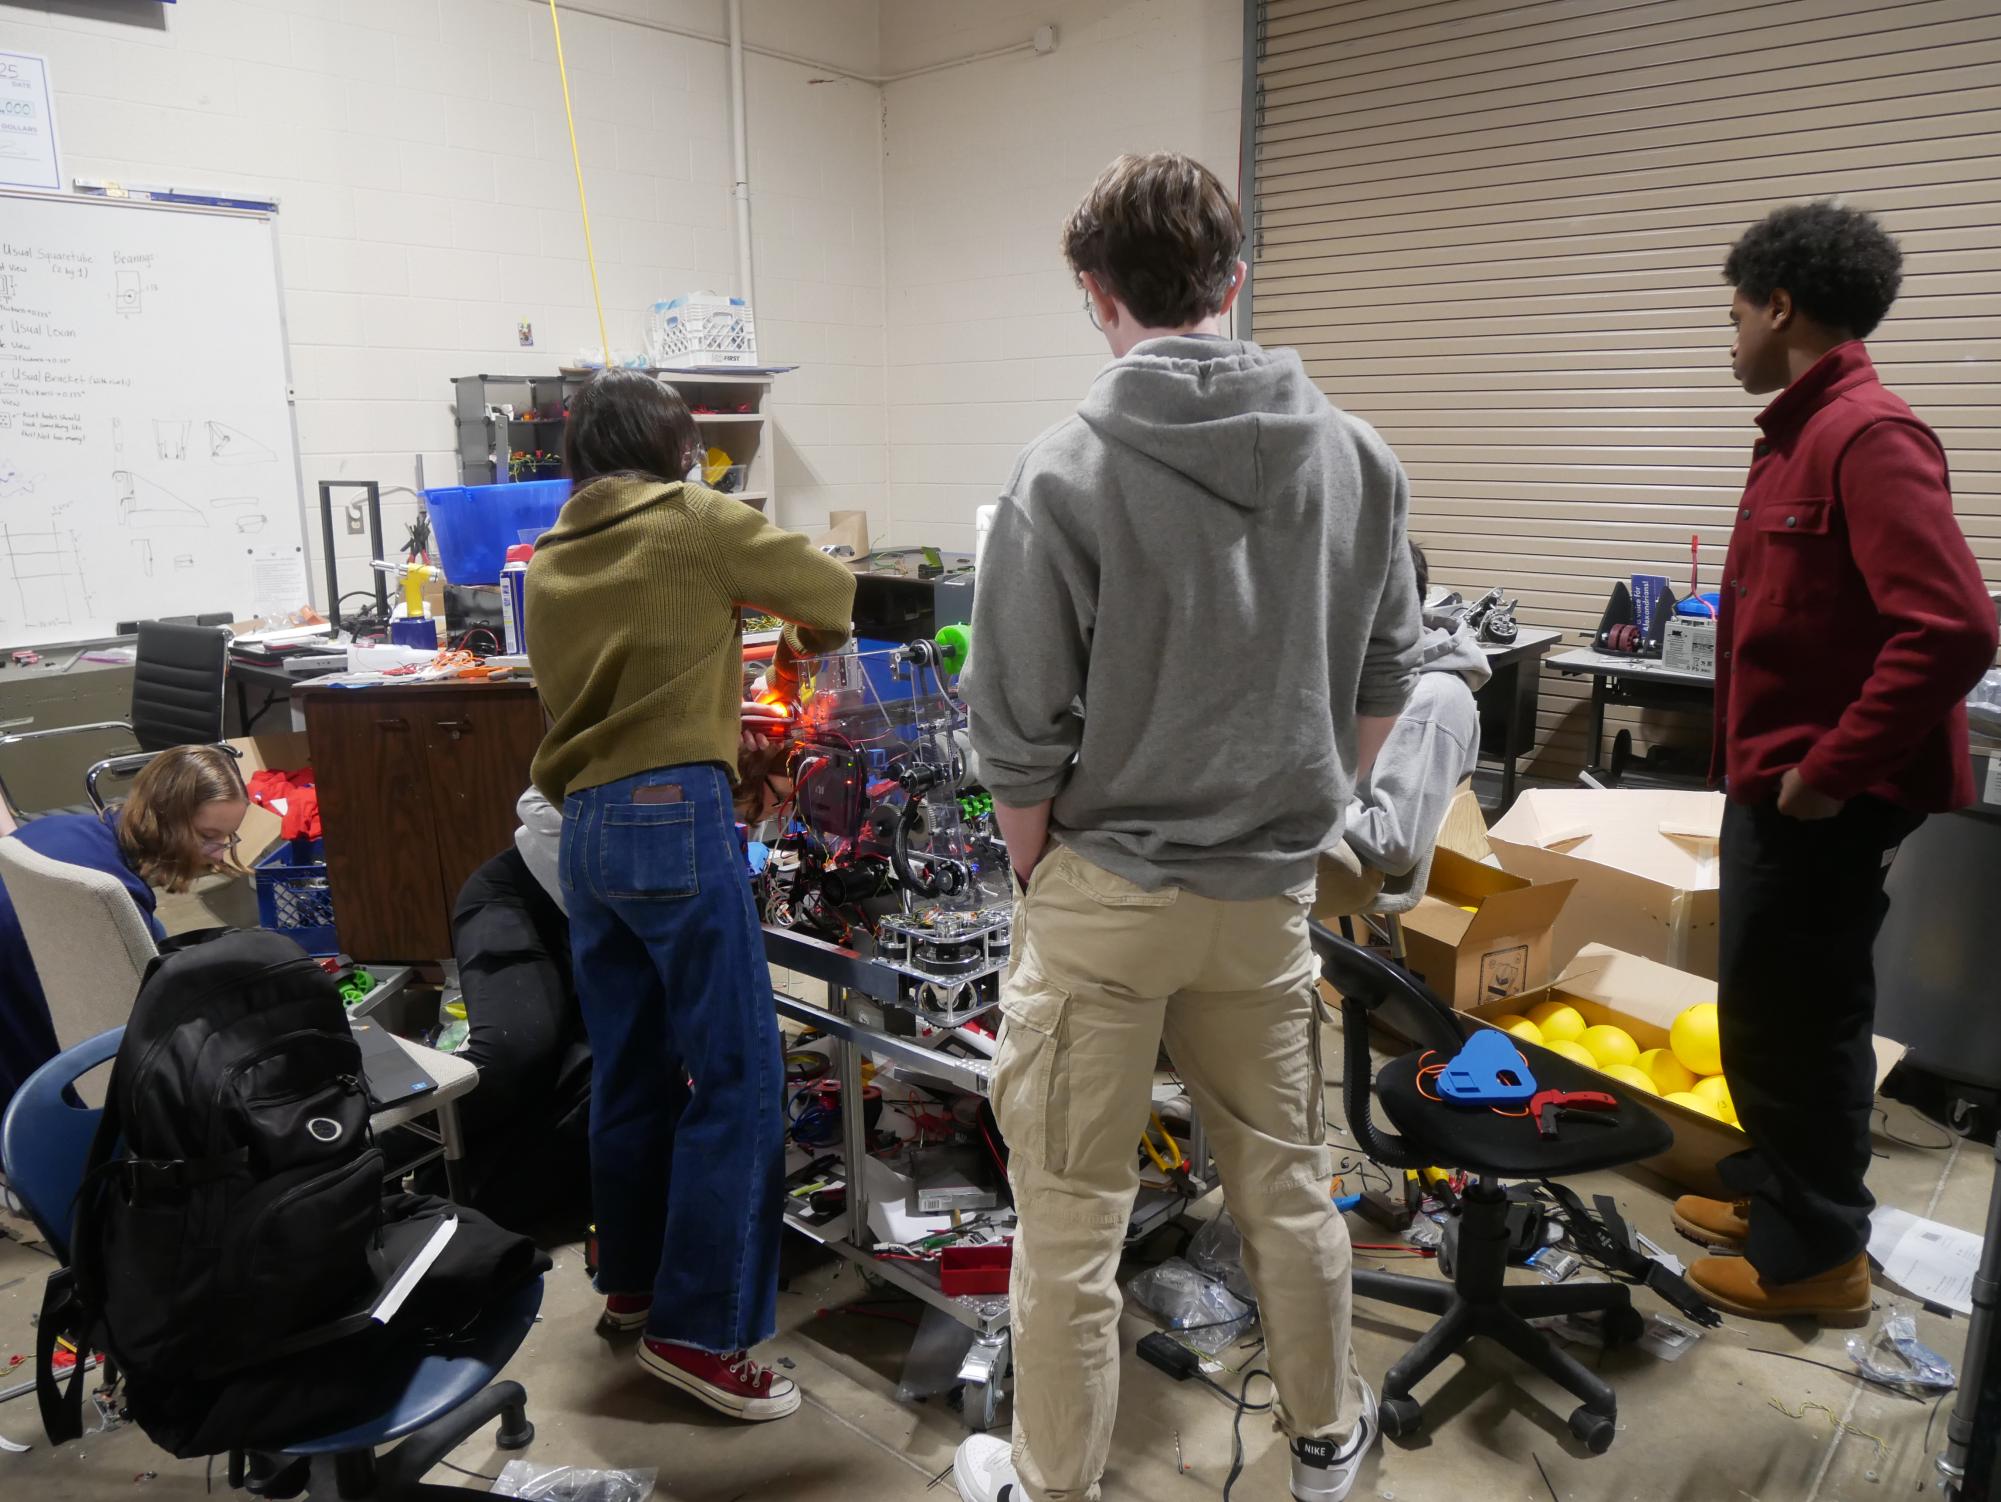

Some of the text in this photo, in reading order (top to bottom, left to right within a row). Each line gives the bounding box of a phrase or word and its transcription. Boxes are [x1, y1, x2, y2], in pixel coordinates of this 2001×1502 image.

[1, 122, 38, 133] DOLLARS
[3, 243, 32, 258] Usual
[11, 319, 42, 335] Usual
[12, 368, 41, 383] Usual
[1633, 585, 1641, 598] for
[1641, 580, 1650, 632] Alexandrians!
[1304, 1443, 1327, 1456] NIKE
